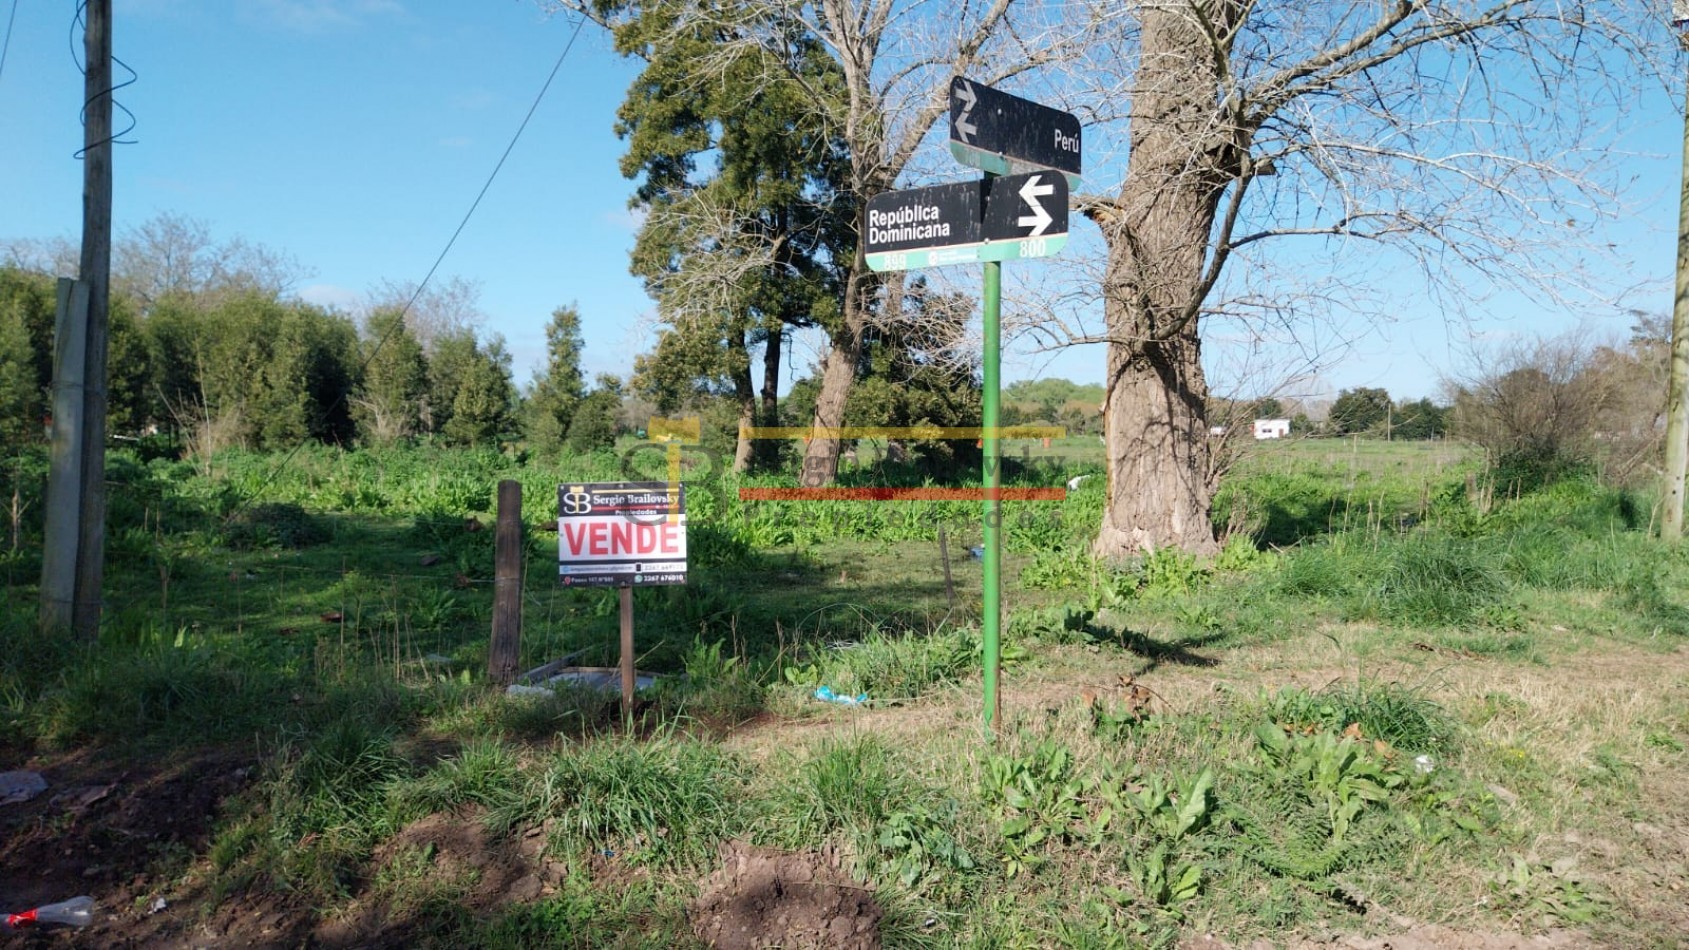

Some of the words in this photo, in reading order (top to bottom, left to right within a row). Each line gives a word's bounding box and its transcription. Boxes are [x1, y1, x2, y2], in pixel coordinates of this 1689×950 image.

[1054, 129, 1080, 153] Perú
[869, 204, 939, 228] República
[869, 222, 950, 244] Dominicana
[1019, 239, 1046, 257] 800
[563, 492, 592, 514] SB
[593, 495, 625, 506] Sergio
[627, 493, 680, 505] Brailovsky
[564, 522, 678, 555] VENDE
[644, 574, 660, 582] 2267
